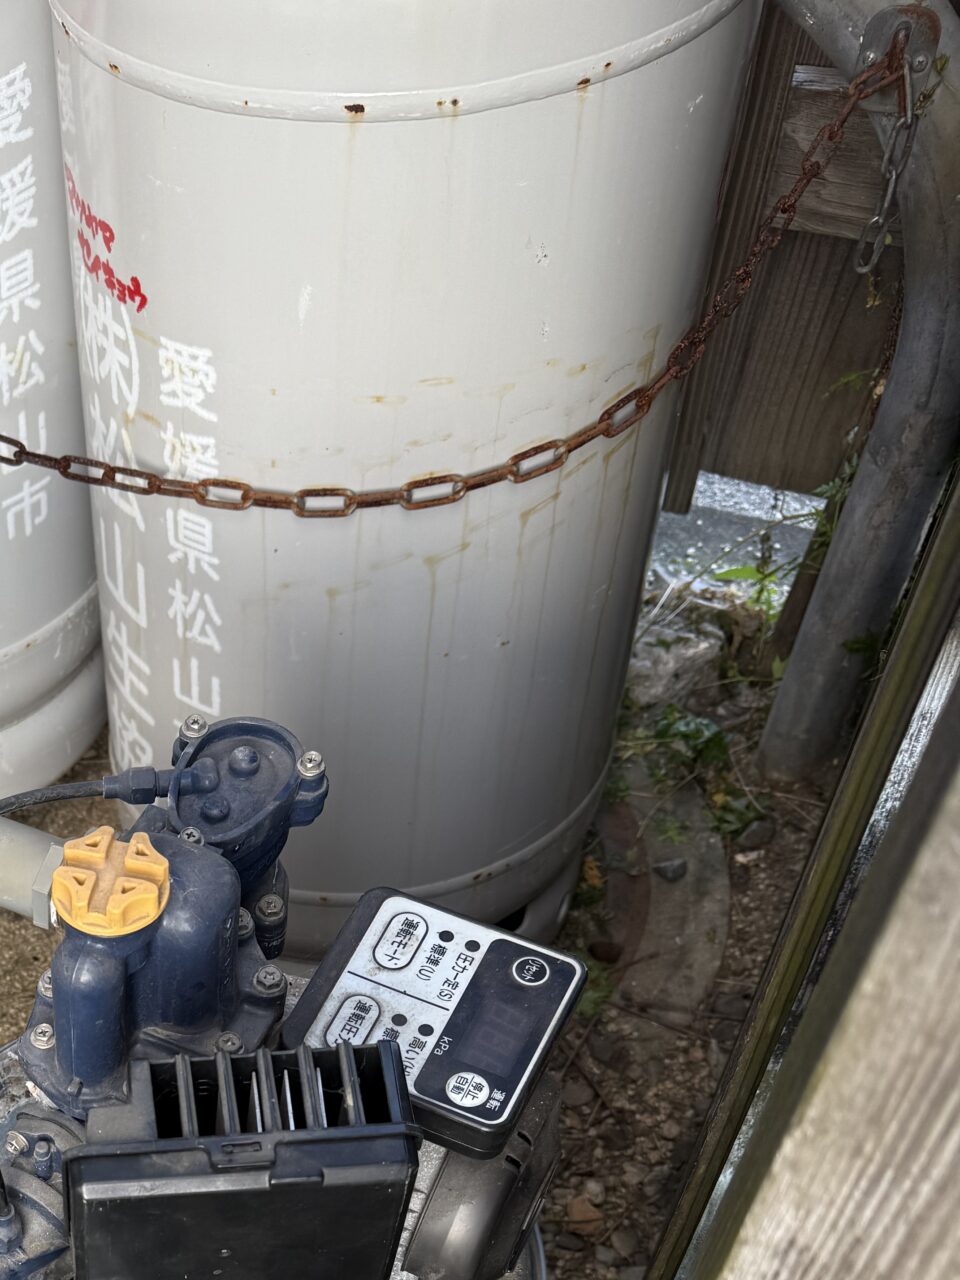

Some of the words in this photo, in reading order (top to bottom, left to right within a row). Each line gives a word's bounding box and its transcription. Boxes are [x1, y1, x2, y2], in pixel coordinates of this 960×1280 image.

[158, 335, 222, 728] 愛媛県松山
[434, 1036, 453, 1056] kPa
[450, 1075, 469, 1095] 自動
